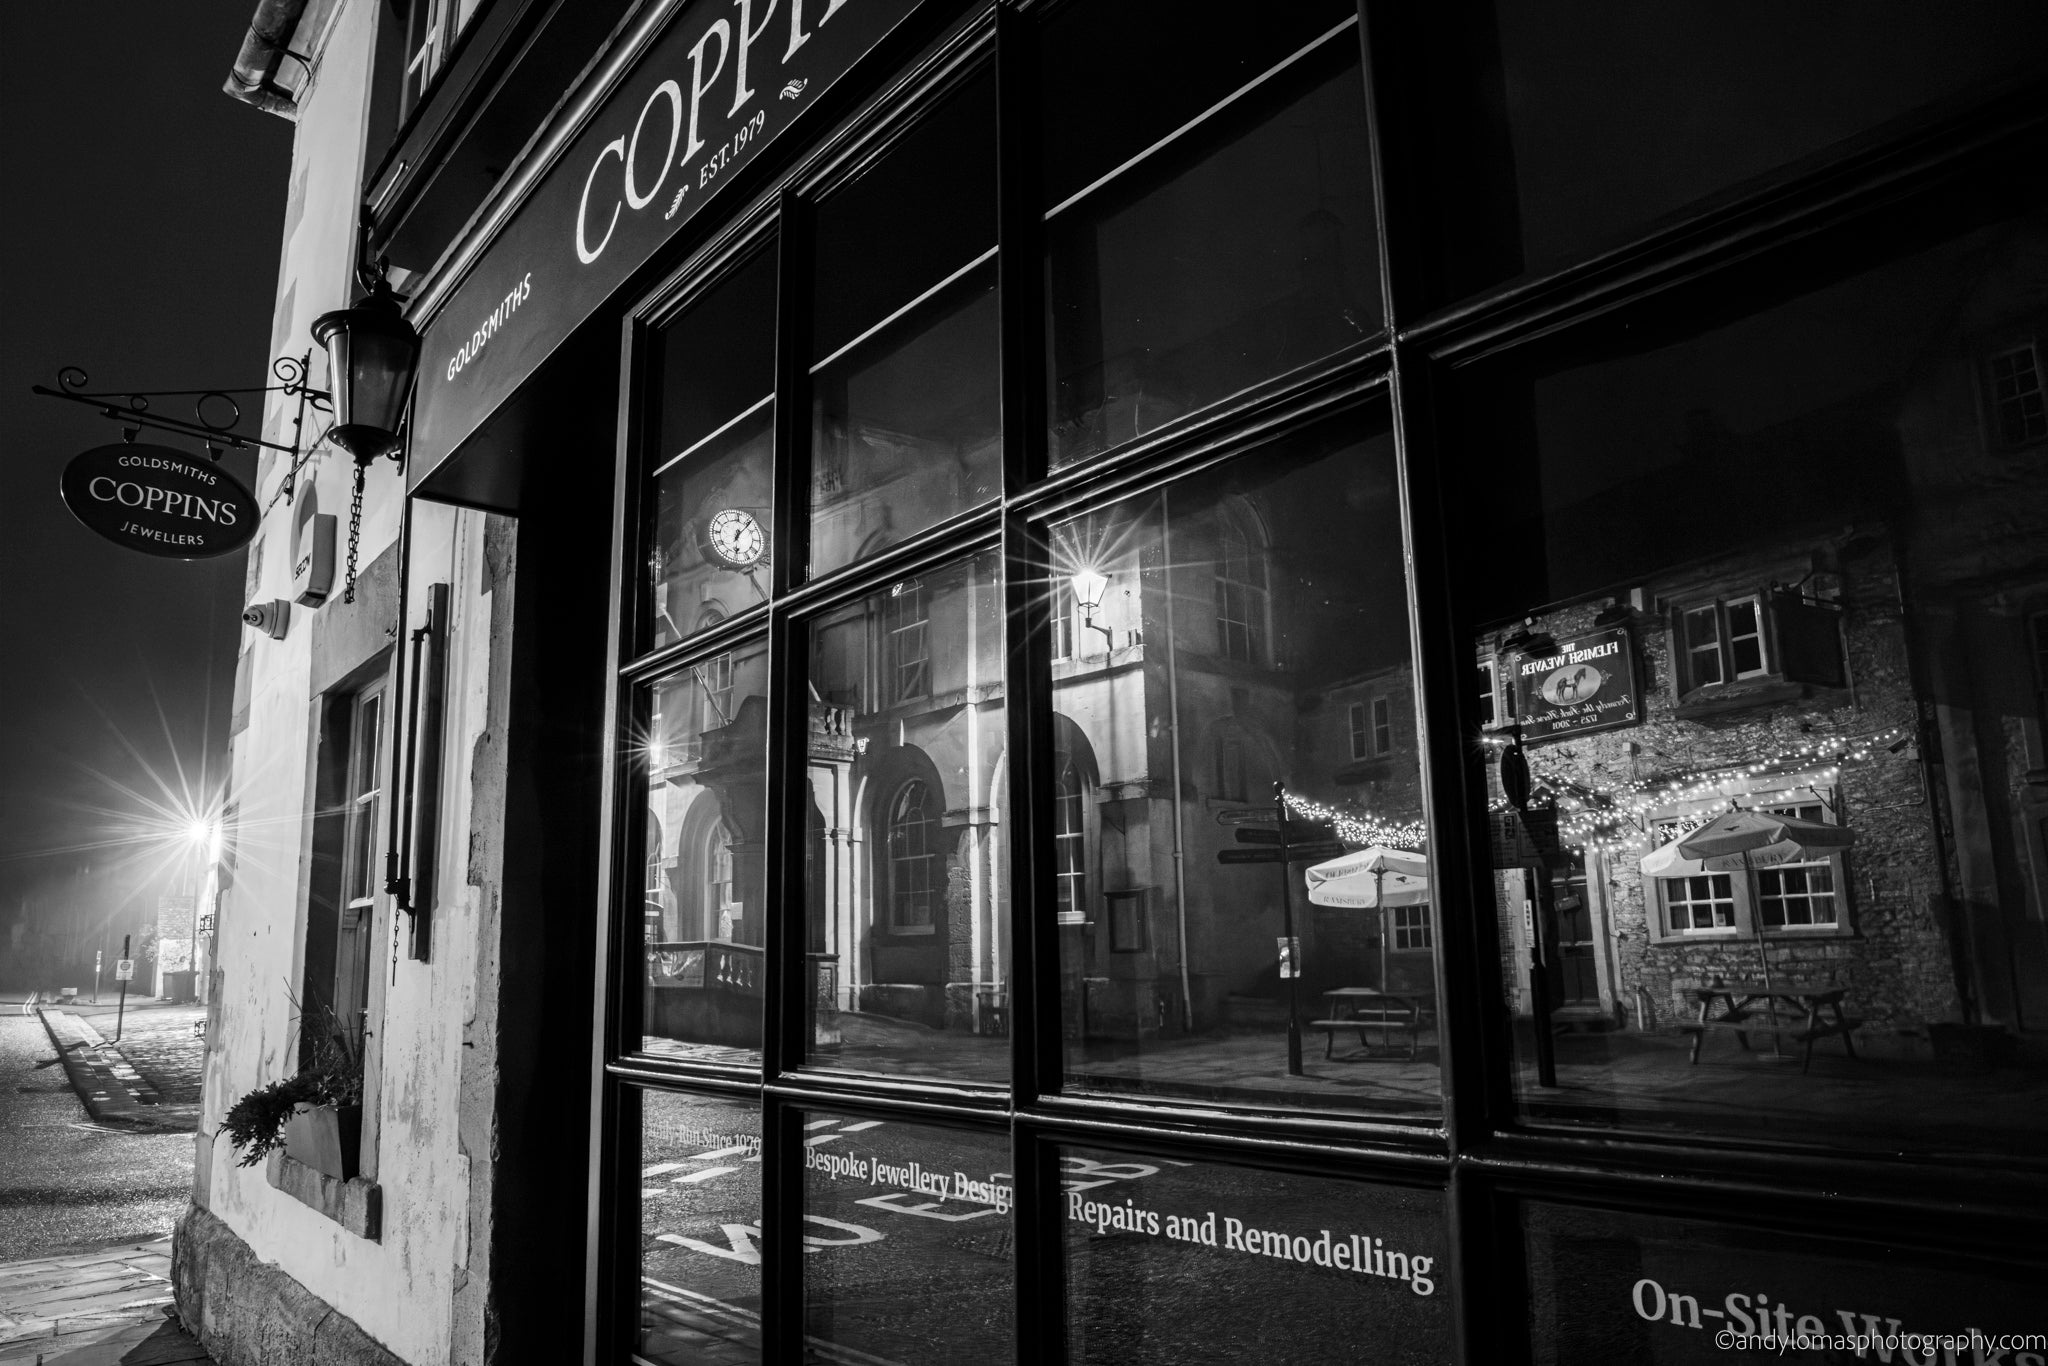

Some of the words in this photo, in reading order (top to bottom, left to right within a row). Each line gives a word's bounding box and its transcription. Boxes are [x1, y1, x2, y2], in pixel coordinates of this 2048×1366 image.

[698, 144, 730, 190] EST.
[733, 109, 766, 156] 1979
[446, 272, 532, 382] GOLDSMITHS
[118, 455, 217, 486] GOLDSMITHS
[89, 476, 237, 526] COPPINS
[120, 521, 205, 546] JEWELLERS
[702, 1127, 732, 1150] Since
[733, 1133, 762, 1158] 1979
[805, 1146, 868, 1182] Bespoke
[870, 1157, 950, 1202] Jewellery
[1068, 1192, 1160, 1235] Repairs
[1166, 1212, 1217, 1247] and
[1224, 1217, 1435, 1296] Remodelling
[1632, 1279, 1826, 1351] On-Site
